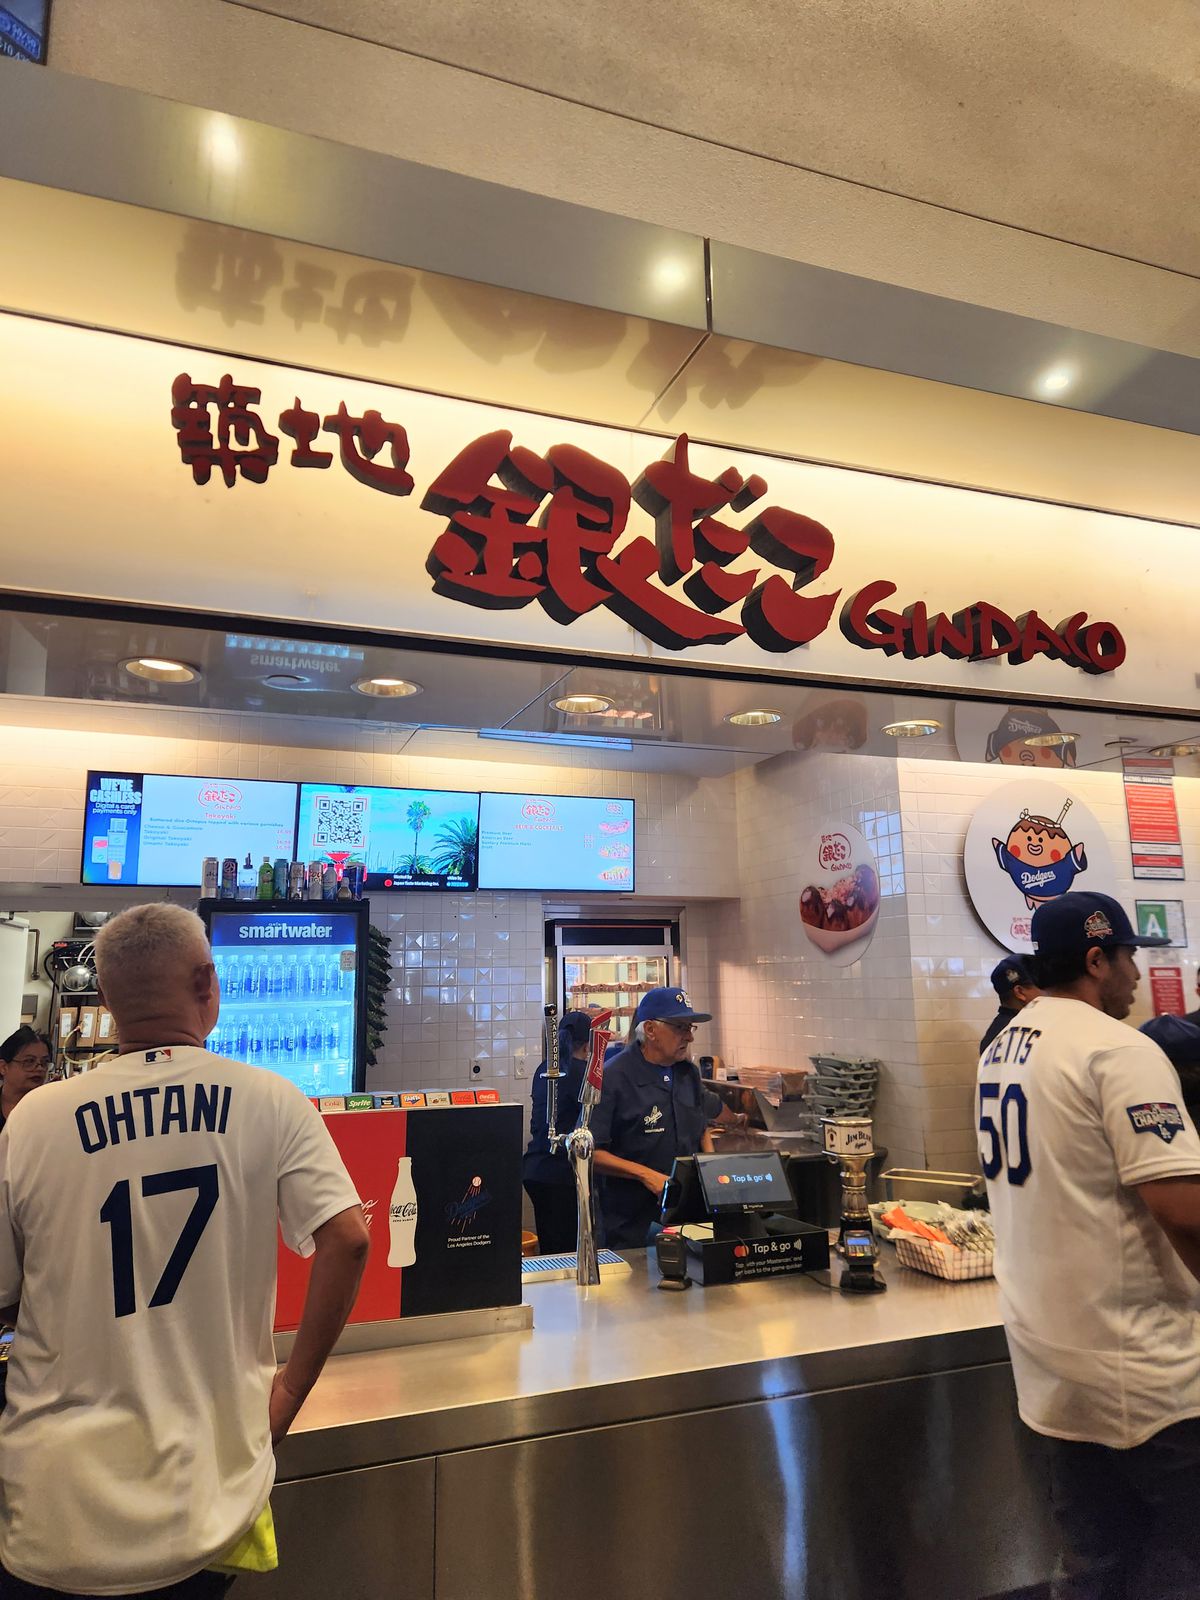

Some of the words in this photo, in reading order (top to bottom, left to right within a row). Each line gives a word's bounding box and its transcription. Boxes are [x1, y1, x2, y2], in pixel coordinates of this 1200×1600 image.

[420, 432, 842, 653] 銀だこ
[839, 580, 1126, 675] GINDACO
[100, 778, 134, 791] WE'RE
[89, 789, 142, 804] CASHLESS
[1021, 870, 1057, 889] Dodgers
[238, 922, 333, 938] smartwater
[1145, 913, 1164, 937] A
[550, 1015, 559, 1068] SAPPORO
[348, 1099, 371, 1108] Sprite
[75, 1083, 232, 1154] OHTANI
[845, 1133, 858, 1146] JIM
[979, 1082, 1032, 1186] 50
[731, 1174, 746, 1183] Tap
[746, 1173, 753, 1182] &
[753, 1175, 764, 1183] go
[100, 1163, 220, 1318] 17
[752, 1243, 770, 1254] Tap
[770, 1241, 778, 1252] &
[779, 1242, 791, 1252] go
